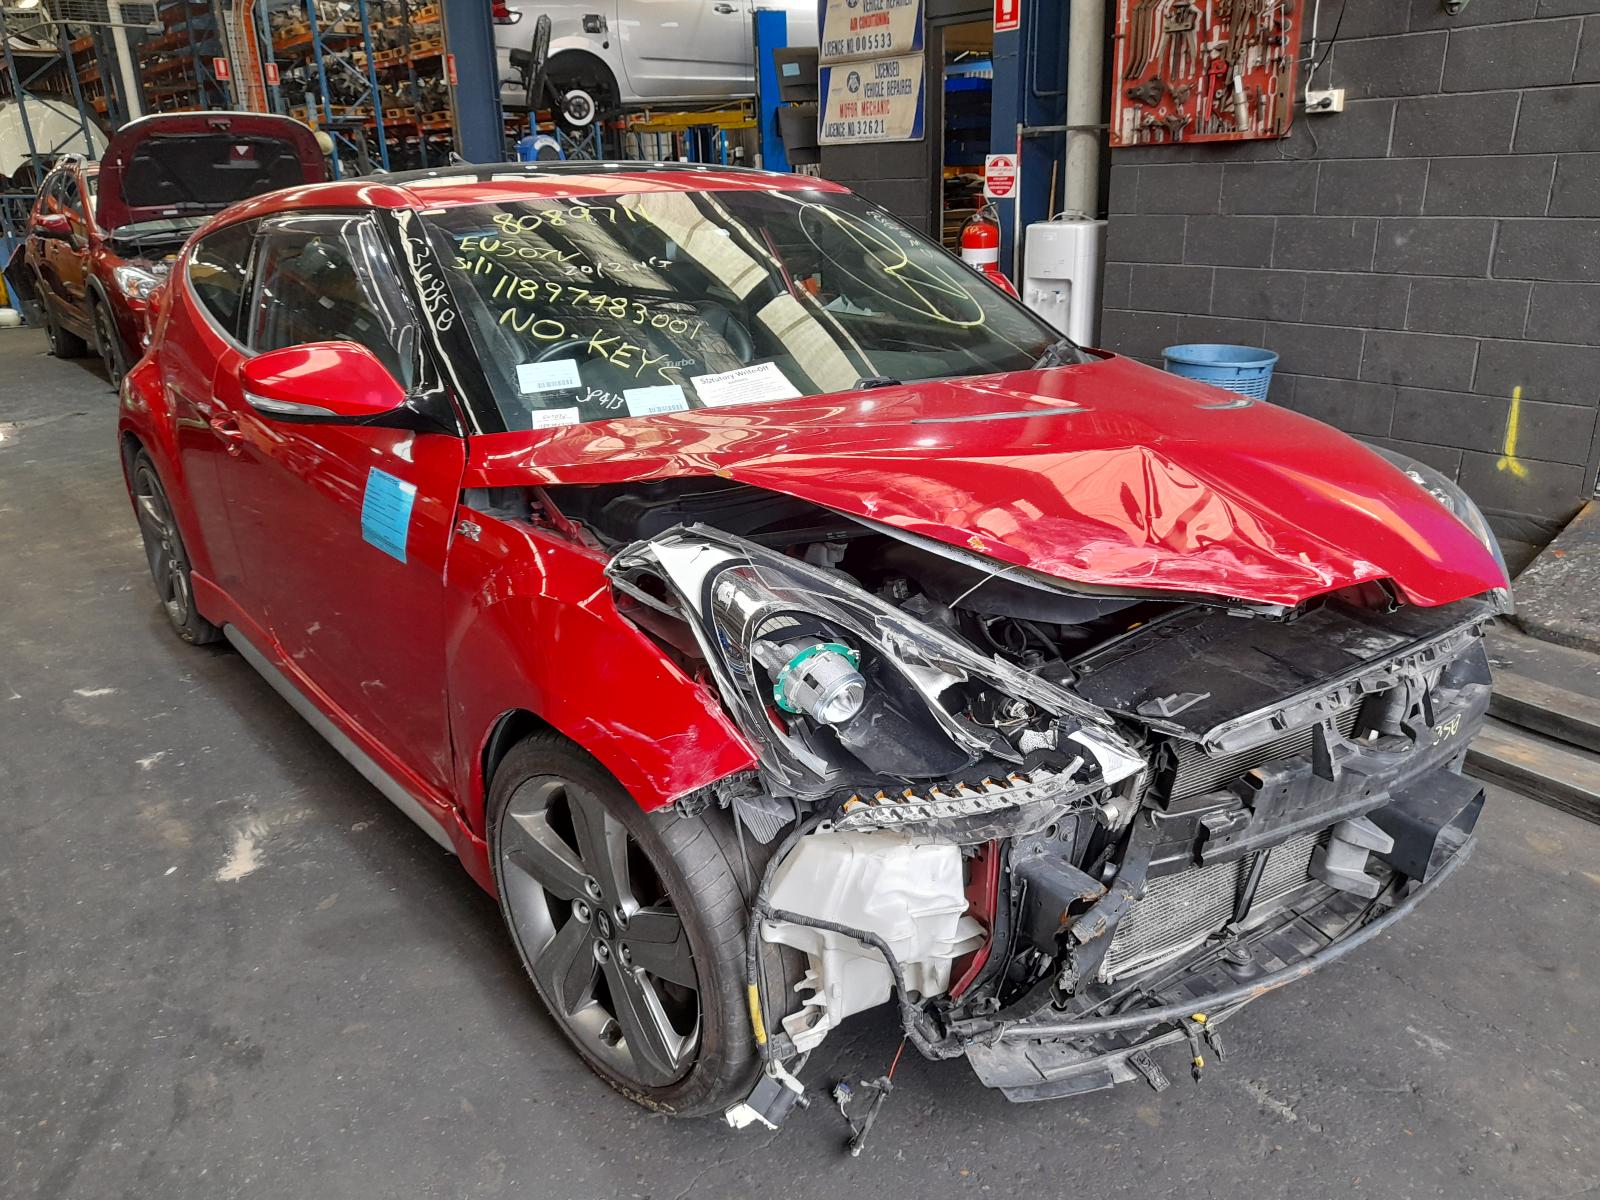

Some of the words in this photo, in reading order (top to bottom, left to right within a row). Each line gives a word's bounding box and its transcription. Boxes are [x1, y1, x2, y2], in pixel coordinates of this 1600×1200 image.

[859, 11, 890, 29] CONDITIONING
[824, 39, 844, 57] LICENCE
[856, 32, 892, 51] 005533
[874, 61, 899, 79] LICENSED
[864, 82, 884, 98] VEHICLE
[887, 79, 912, 96] REPAIRER
[840, 102, 857, 118] MOTOR
[861, 100, 890, 116] MECHANIC
[825, 122, 845, 137] LICENCE
[857, 119, 885, 135] 32621
[588, 329, 683, 385] KEYS
[664, 357, 696, 367] Turbo
[700, 373, 735, 385] Statutory
